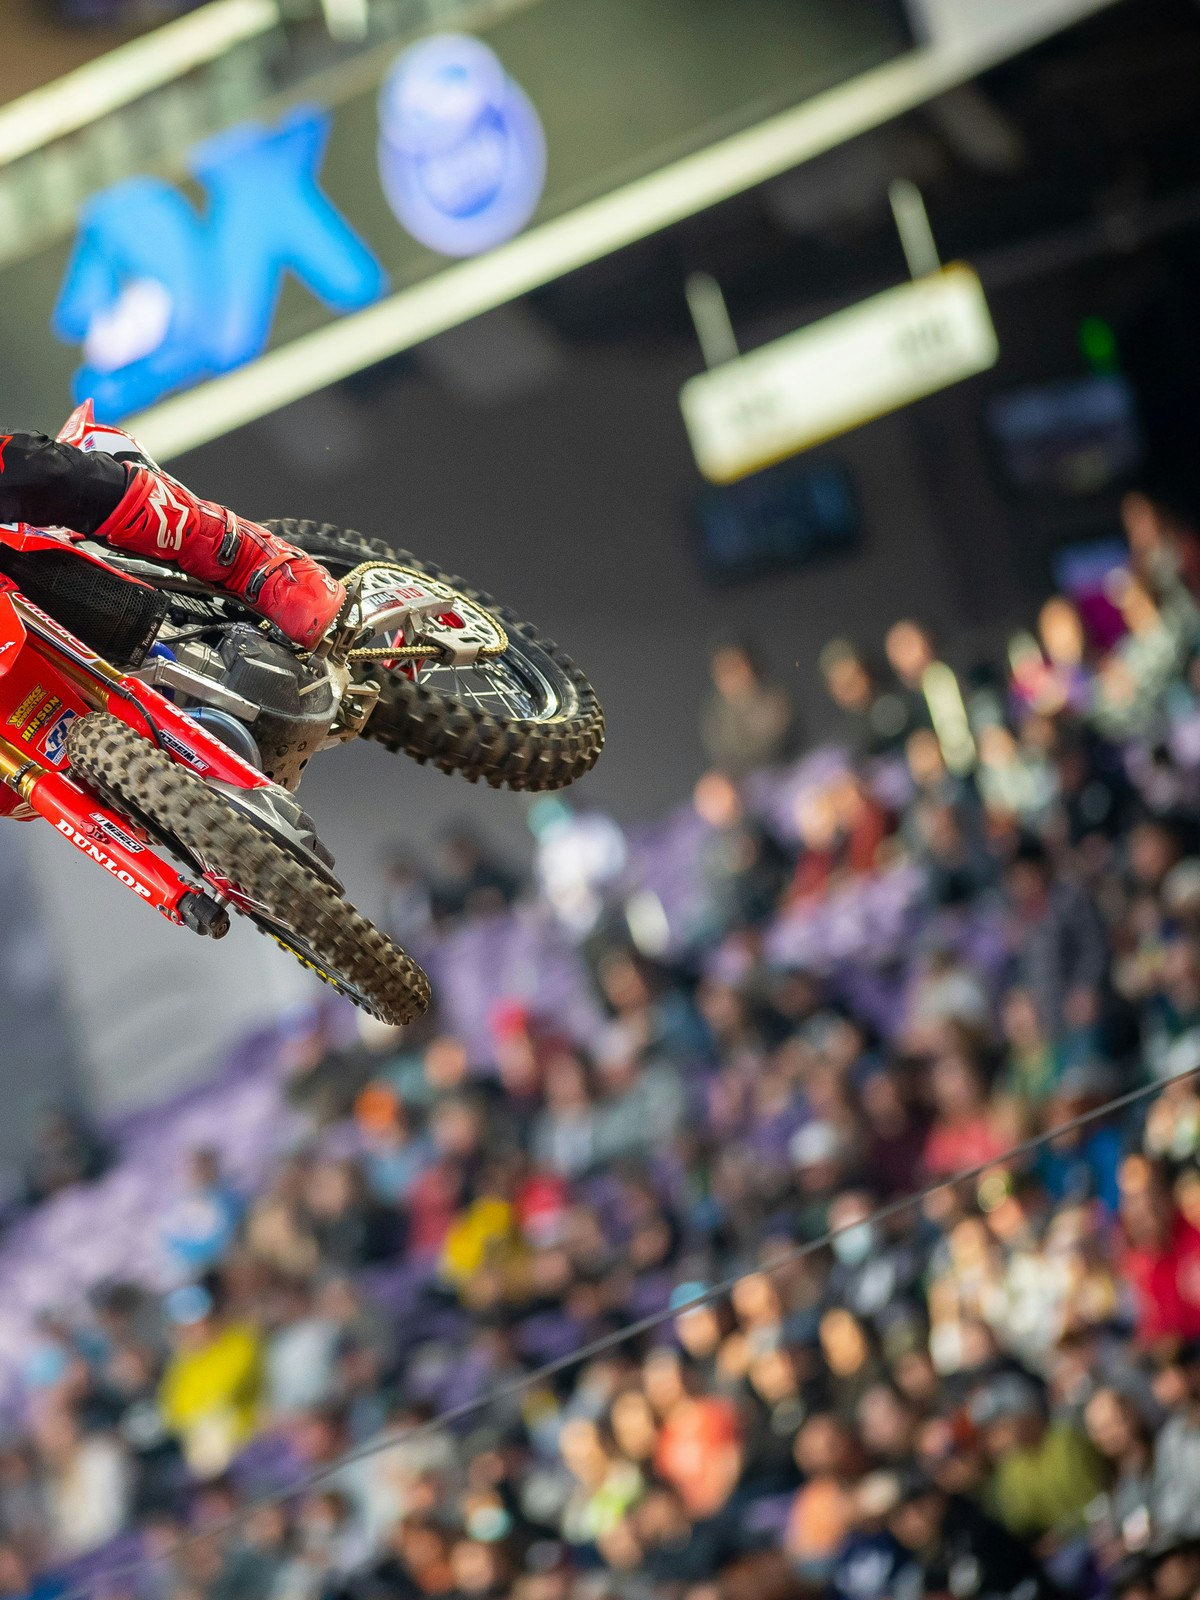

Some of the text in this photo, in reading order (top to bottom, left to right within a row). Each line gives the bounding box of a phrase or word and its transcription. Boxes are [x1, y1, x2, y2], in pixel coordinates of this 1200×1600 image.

[8, 685, 43, 724] WORKS
[21, 695, 60, 742] HINSON
[55, 817, 152, 899] DUNLOP
